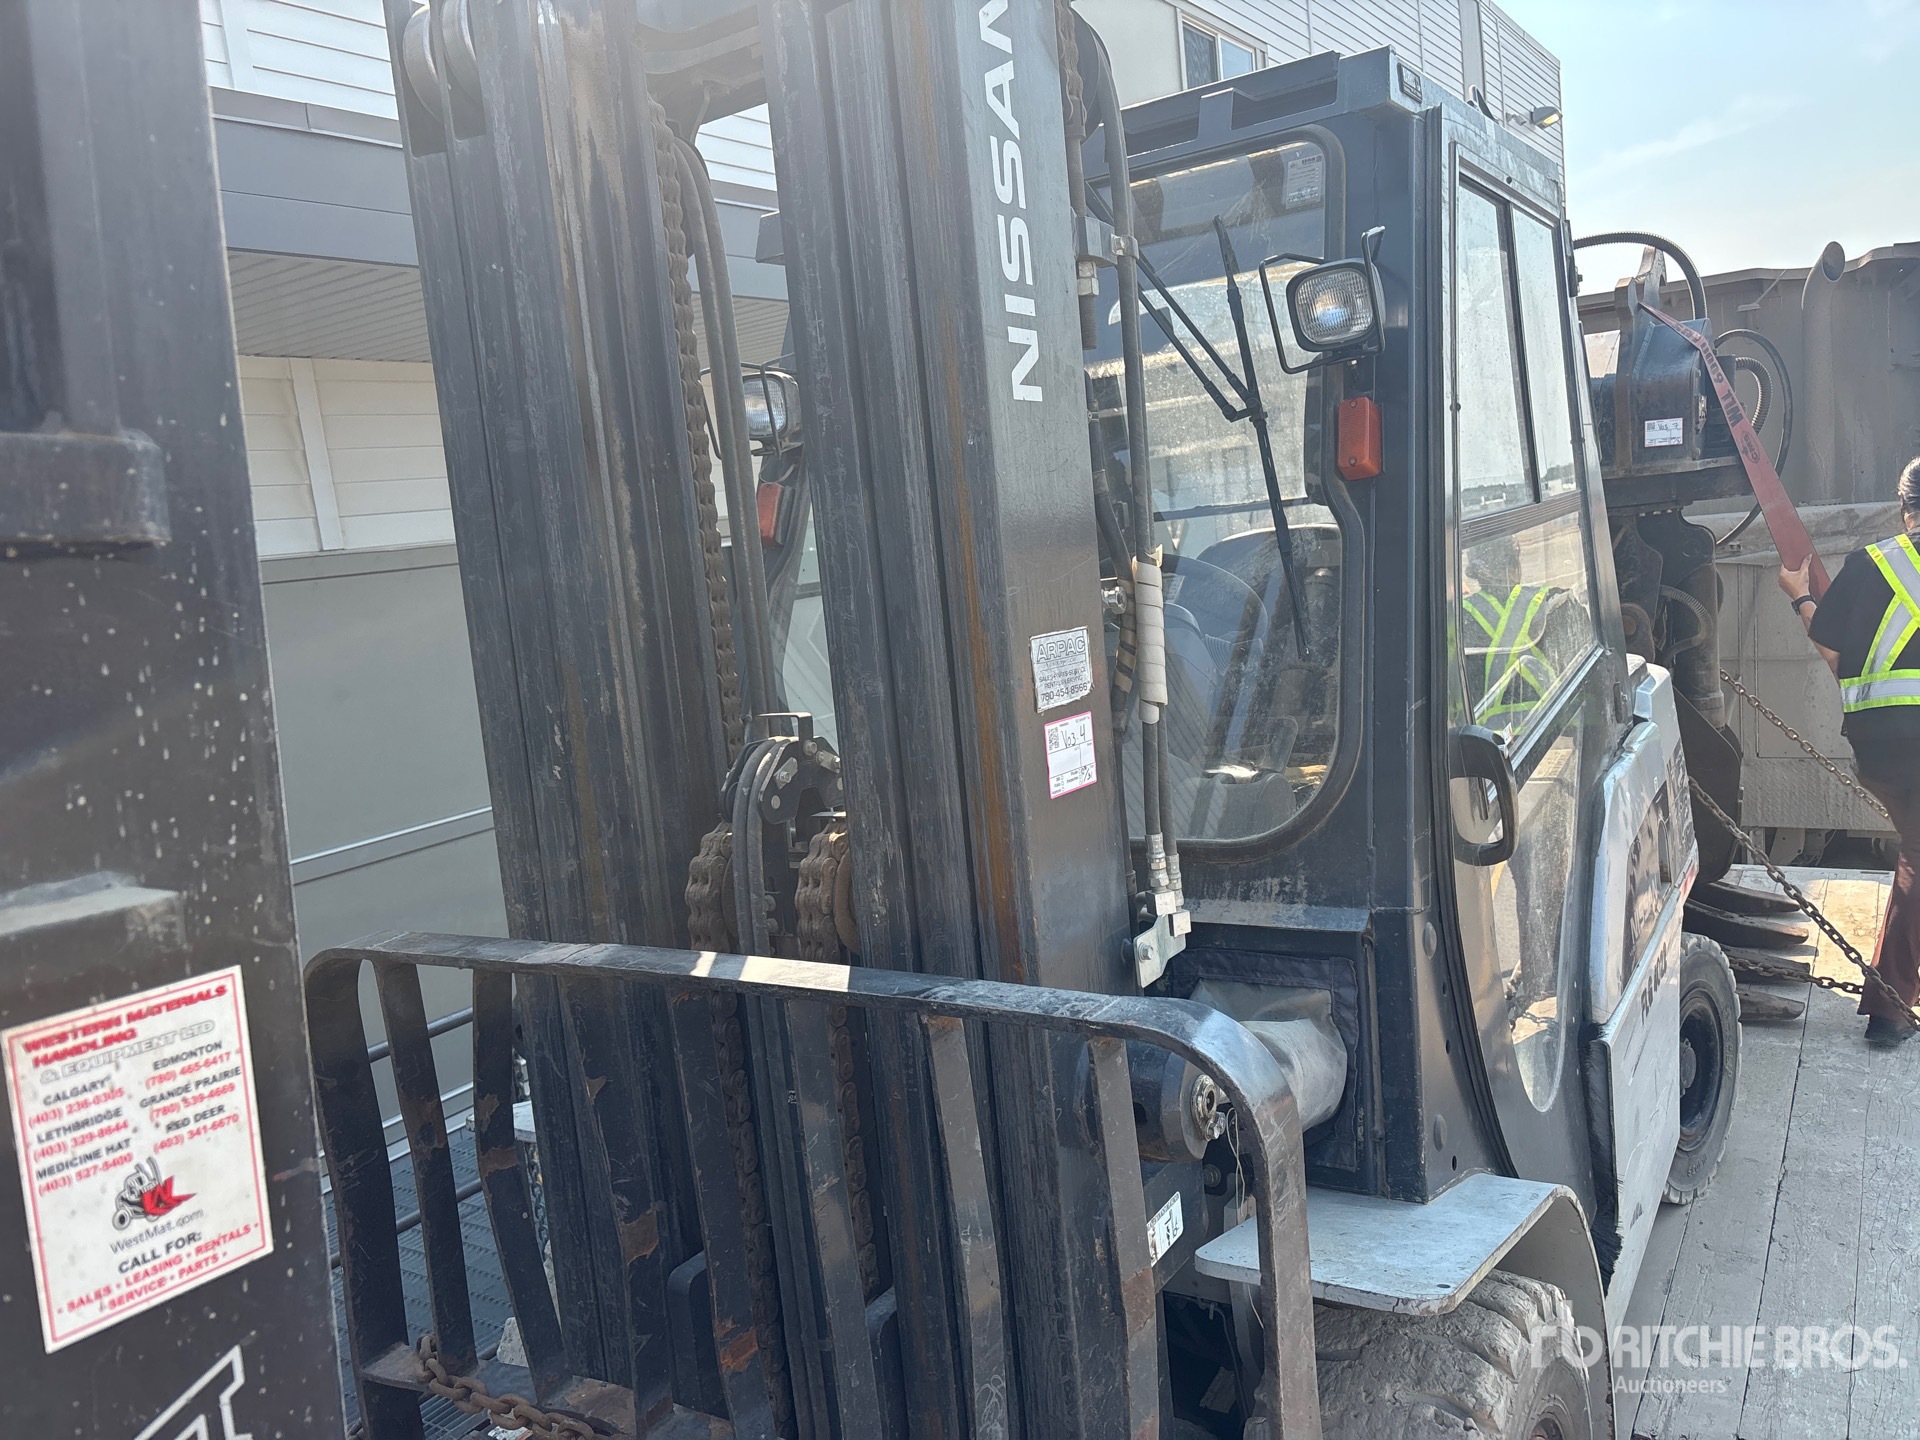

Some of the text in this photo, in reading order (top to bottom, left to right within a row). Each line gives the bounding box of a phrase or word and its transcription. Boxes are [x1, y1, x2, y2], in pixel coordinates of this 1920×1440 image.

[1720, 388, 1744, 428] WLL
[1037, 636, 1085, 662] ARPAC
[22, 985, 227, 1053] WESTERN MATERIALS
[32, 1027, 137, 1069] HANDLING
[61, 1030, 178, 1077] EQUIPMENT
[180, 1019, 215, 1041] LTD
[152, 1040, 223, 1070] EDMONTON
[43, 1078, 108, 1106] CALGARY
[139, 1066, 242, 1109] GRANDE PRAIRIE
[145, 1070, 178, 1090] (780)
[29, 1107, 64, 1129] (403)
[36, 1106, 123, 1144] LETHBRIDGE
[149, 1102, 182, 1125] (780)
[165, 1104, 226, 1134] RED DEER
[33, 1141, 69, 1163] (403)
[36, 1137, 131, 1180] MEDICINE HAT
[153, 1133, 185, 1155] (403)
[38, 1175, 73, 1198] (403)
[109, 1208, 204, 1254] WestMat.com
[67, 1225, 251, 1312] SALES LEASING RENTALS
[118, 1231, 202, 1274] CALL FOR:
[108, 1254, 219, 1310] SERVICE PARTS
